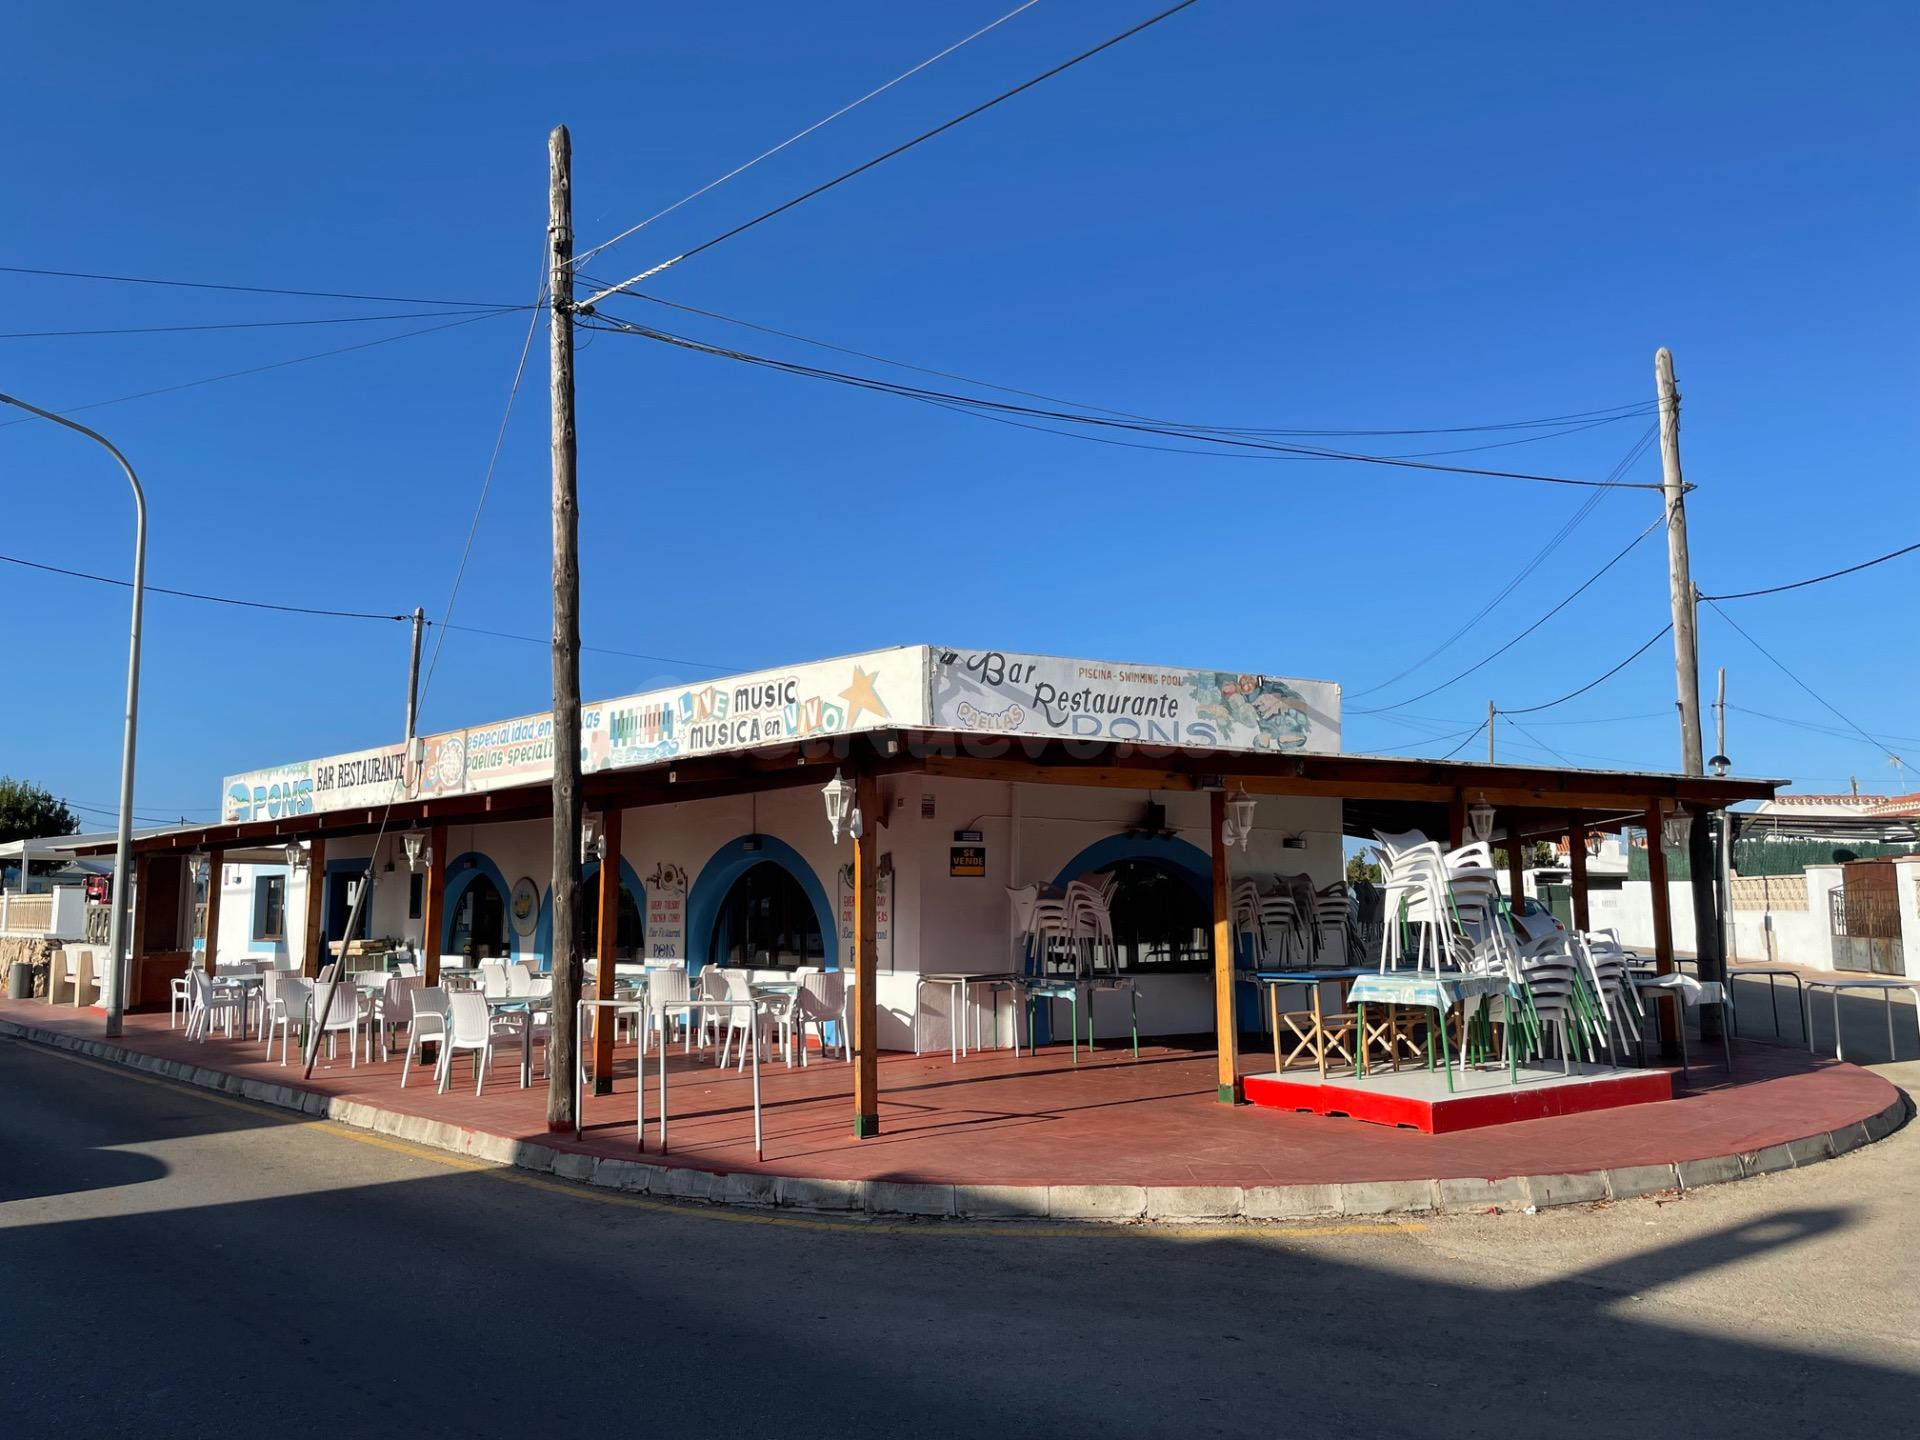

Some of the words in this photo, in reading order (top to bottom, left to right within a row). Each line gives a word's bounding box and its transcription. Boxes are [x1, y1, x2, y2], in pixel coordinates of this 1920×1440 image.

[967, 651, 1036, 686] Bar
[1079, 667, 1112, 681] PISCINA
[1119, 670, 1158, 685] SWIMMING
[1161, 674, 1183, 687] POOL
[679, 688, 728, 723] LIVE
[735, 680, 796, 712] MUSIC
[960, 704, 1022, 729] PAELLAS
[1032, 682, 1178, 728] Restaurante
[467, 721, 534, 749] especialidad
[538, 719, 552, 737] en
[690, 718, 760, 749] MUSICA
[765, 719, 780, 737] en
[784, 697, 841, 735] VIVO
[508, 738, 553, 767] speciali
[317, 765, 334, 792] BAR
[338, 752, 407, 789] RESTAURANTE
[253, 778, 313, 822] PONS
[953, 857, 984, 866] VENDE
[963, 848, 975, 857] SE
